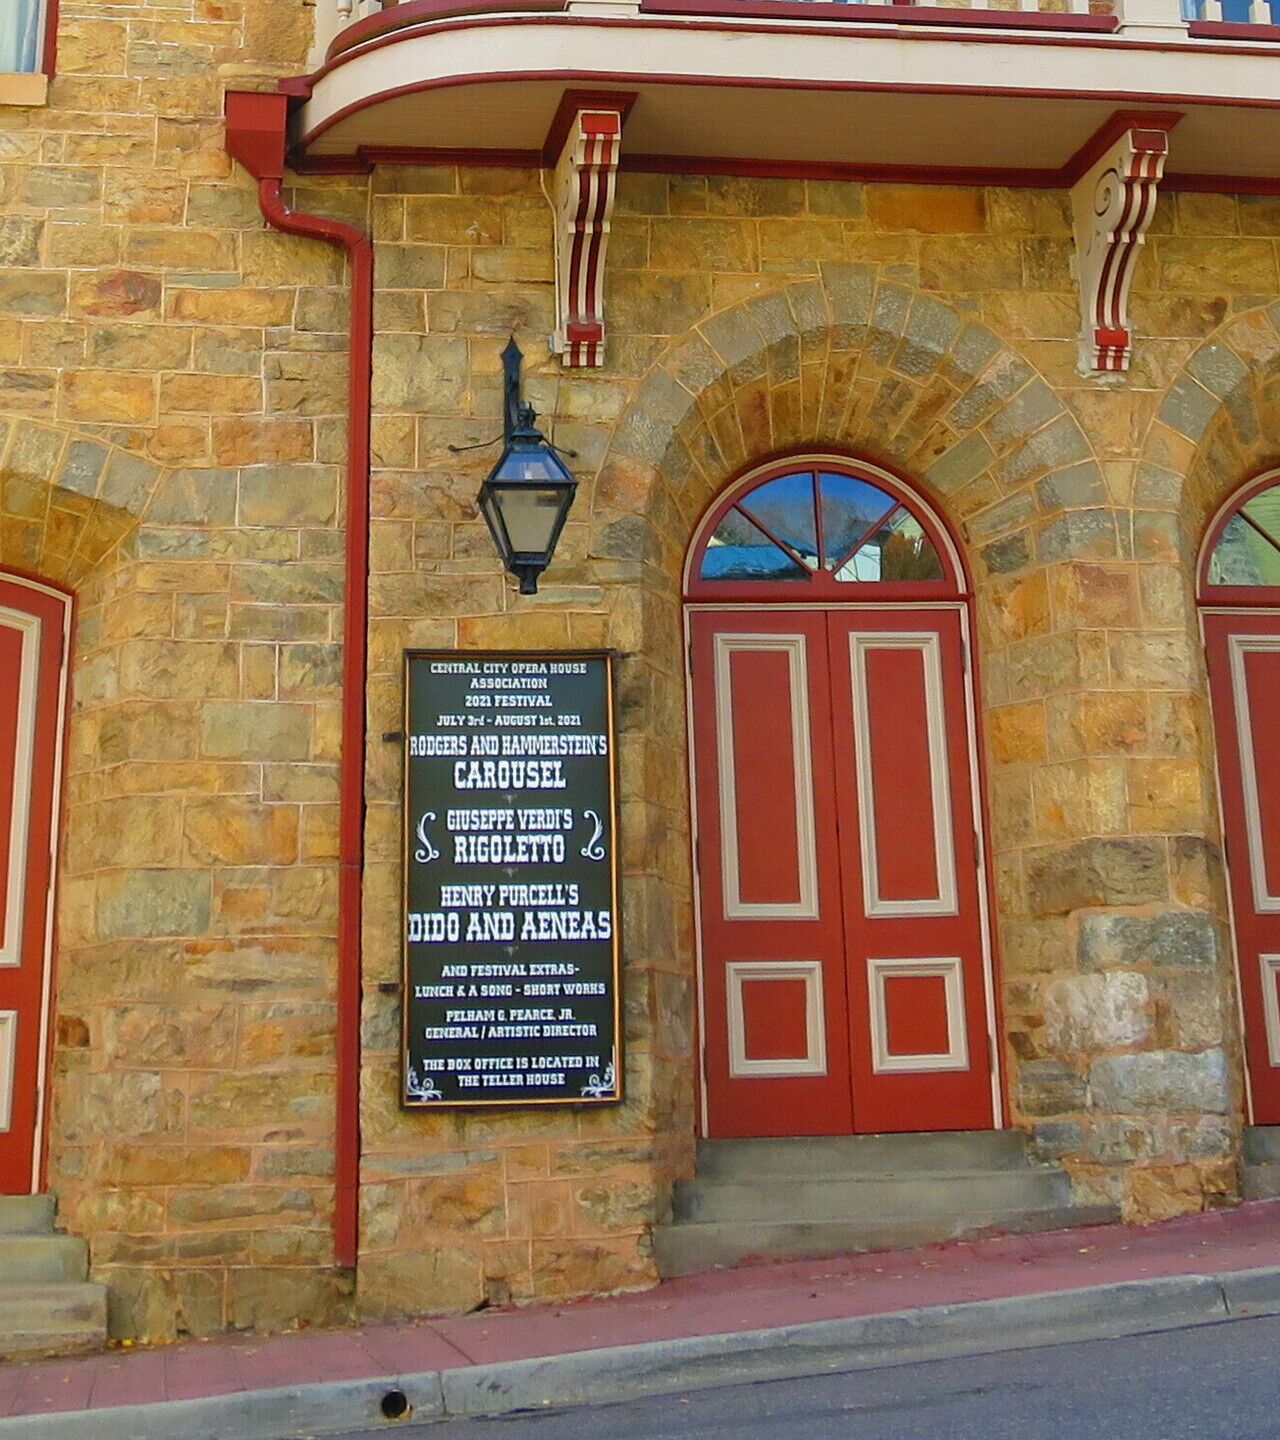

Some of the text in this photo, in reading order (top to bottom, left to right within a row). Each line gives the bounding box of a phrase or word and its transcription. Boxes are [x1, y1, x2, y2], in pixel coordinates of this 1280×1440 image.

[430, 663, 587, 674] CENTRAL CITY OPERA HOUSE
[470, 677, 548, 689] ASSOCIATION
[465, 694, 553, 707] 2021 FESTIVAL
[436, 715, 466, 726] JULY
[467, 715, 485, 726] 3rd
[494, 715, 537, 726] AUGUST
[557, 715, 582, 726] 2021
[409, 734, 608, 756] RODGERS AND HAMMERSTEIN'S
[454, 760, 567, 789] CAROUSEL
[446, 808, 573, 831] GIUSEPPE VERDI'S
[454, 834, 565, 864] RIGOLETTO
[440, 883, 579, 907] HENRY PURCELL'S
[408, 910, 612, 943] DIDO AND AENEAS
[441, 965, 469, 978] AND
[470, 964, 527, 977] FESTIVAL
[414, 985, 455, 998] LUNCH
[456, 985, 466, 997] &
[468, 985, 478, 997] A
[480, 984, 513, 997] SONG
[523, 983, 561, 996] SHORT
[562, 983, 606, 995] WORKS
[446, 1010, 495, 1023] PELHAM
[425, 1026, 479, 1040] GENERAL
[487, 1025, 541, 1038] ARTISTIC
[542, 1024, 598, 1037] DIRECTOR
[422, 1055, 600, 1071] THE BOX OFFICE IS LOCATED IN
[457, 1073, 566, 1087] THE TELLER HOUSE
